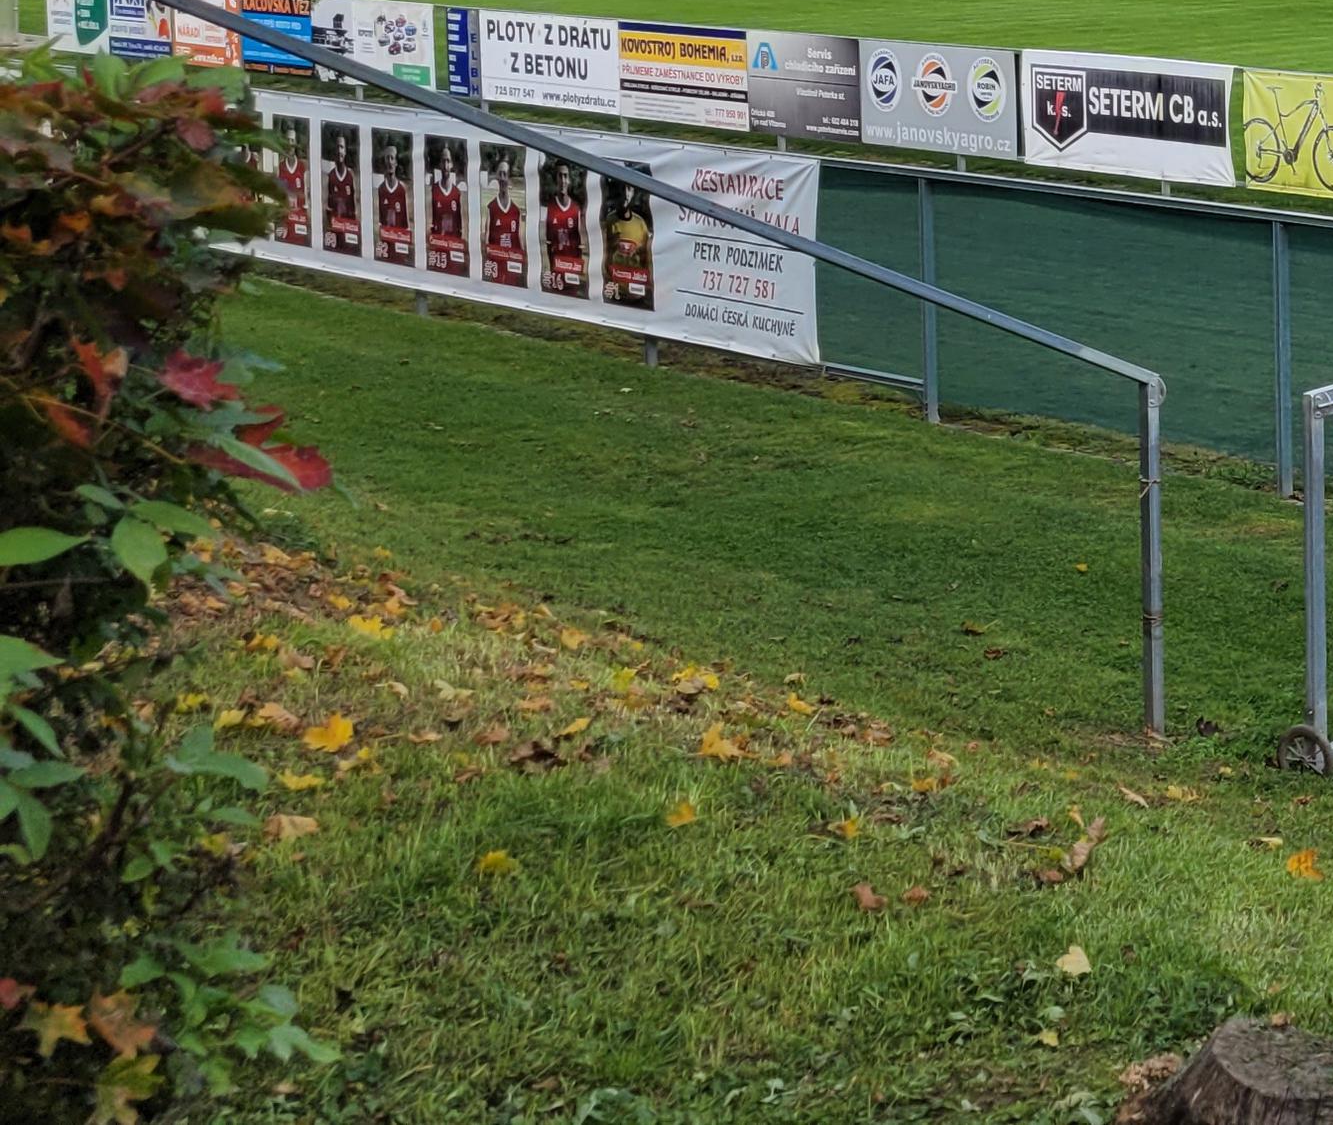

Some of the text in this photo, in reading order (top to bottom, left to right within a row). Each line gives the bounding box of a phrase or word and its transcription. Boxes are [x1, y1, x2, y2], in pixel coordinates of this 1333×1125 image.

[486, 19, 611, 51] PLOTY Z DRÁTU
[621, 38, 676, 60] KOVOSTROJ
[679, 42, 730, 63] BOHEMIA,
[807, 47, 832, 60] Servis
[510, 52, 588, 80] Z BETONU
[622, 64, 744, 85] PŘIJMEME ZAMĚSTNANCE DO VÝROBY
[873, 74, 896, 87] JAFA
[976, 82, 996, 91] ROBIN
[1036, 74, 1082, 92] SETERM
[542, 90, 617, 108] www.plotyzdratu.cz
[1088, 86, 1222, 127] SETERM CB a.s.
[866, 122, 1011, 152] www.janovskyagro.cz
[691, 168, 785, 201] RESTAURACE
[693, 242, 783, 274] PETR PODZIMEK
[702, 270, 775, 300] 737 727 581
[685, 302, 796, 337] DOMÁCÍ ČESKÁ KUCHYNĚ
